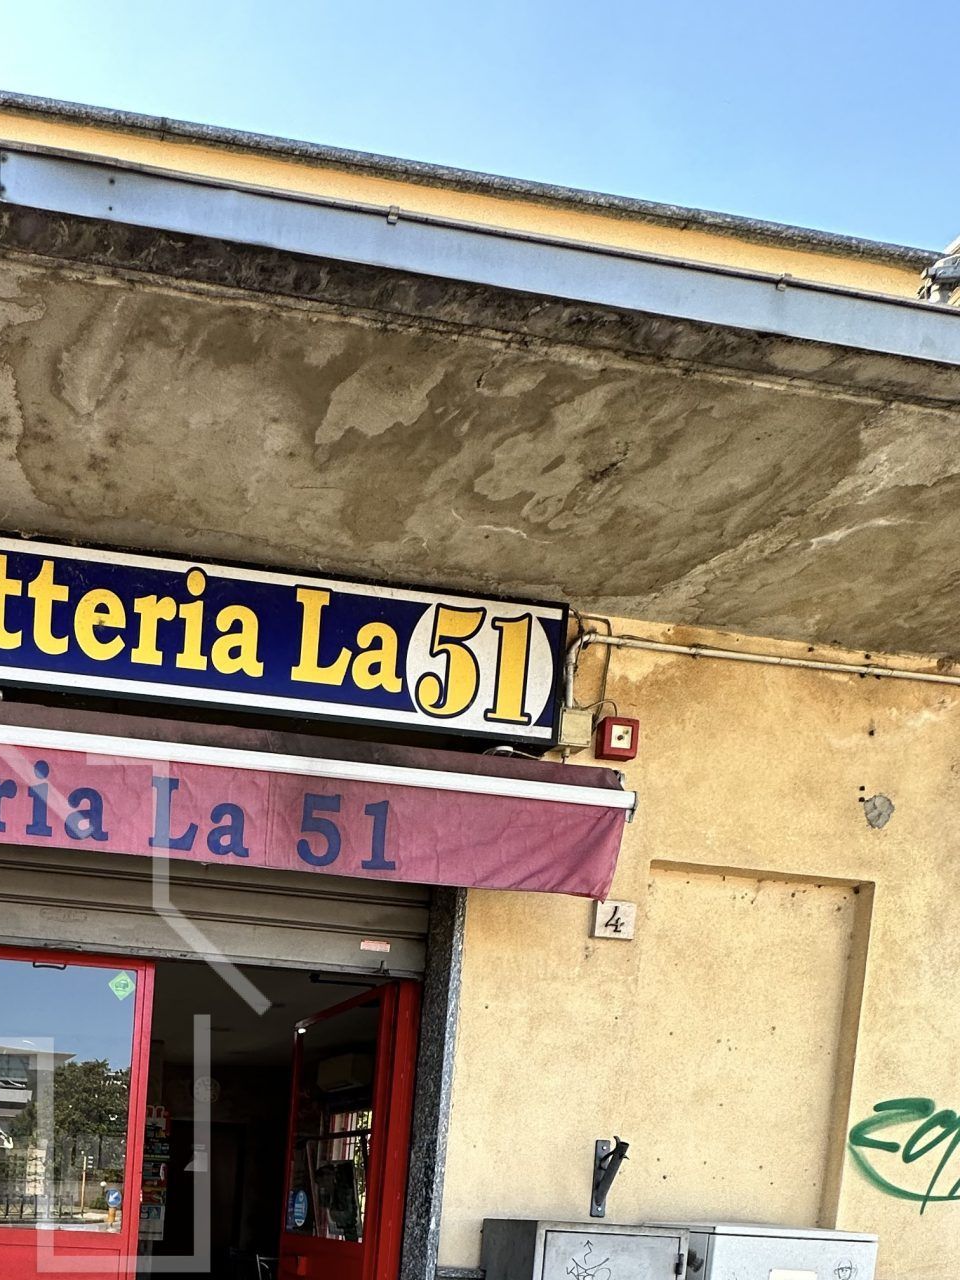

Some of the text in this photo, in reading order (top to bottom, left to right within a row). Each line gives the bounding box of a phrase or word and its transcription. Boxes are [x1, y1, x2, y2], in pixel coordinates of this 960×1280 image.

[290, 587, 403, 693] La
[414, 603, 533, 726] 51
[148, 776, 250, 858] La
[296, 793, 397, 871] 51
[605, 905, 626, 933] 4
